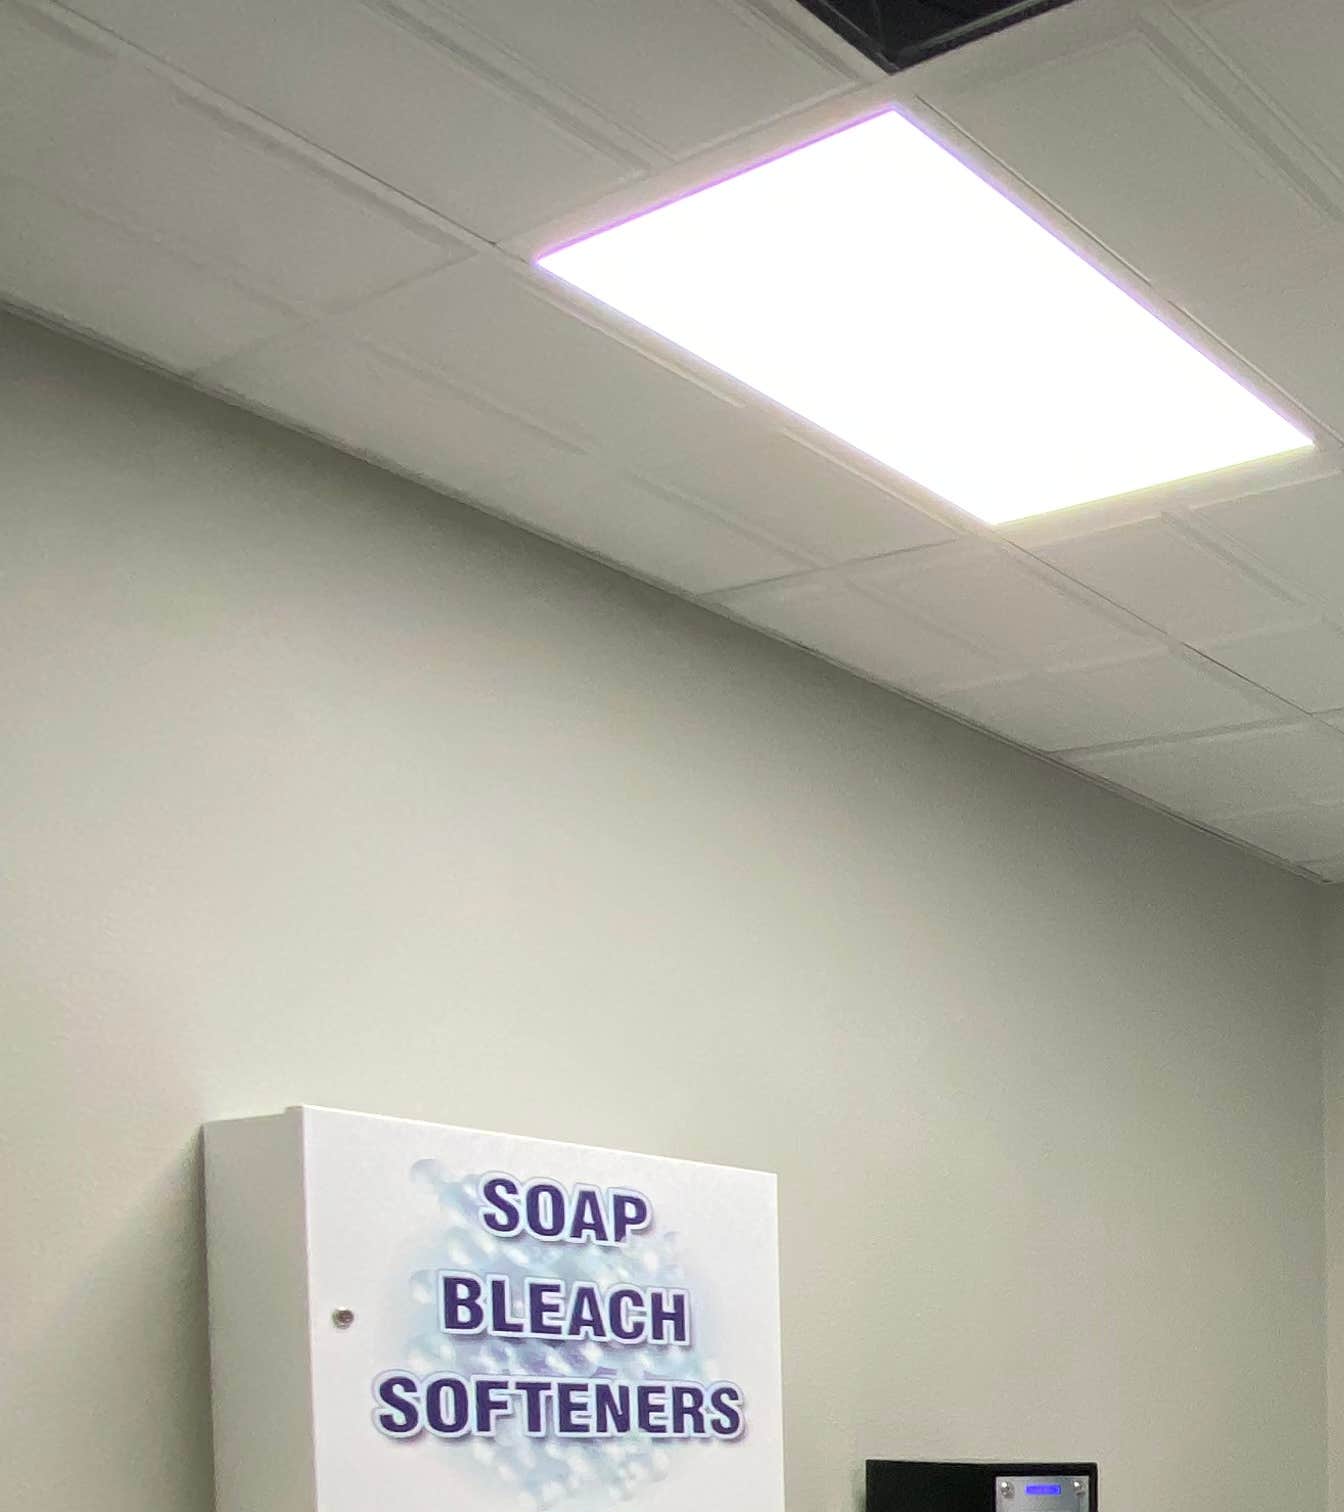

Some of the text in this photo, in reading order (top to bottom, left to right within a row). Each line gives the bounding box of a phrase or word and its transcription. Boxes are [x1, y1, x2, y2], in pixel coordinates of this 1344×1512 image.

[482, 1177, 649, 1243] SOAP
[442, 1275, 687, 1342] BLEACH
[378, 1376, 742, 1435] SOFTENERS
